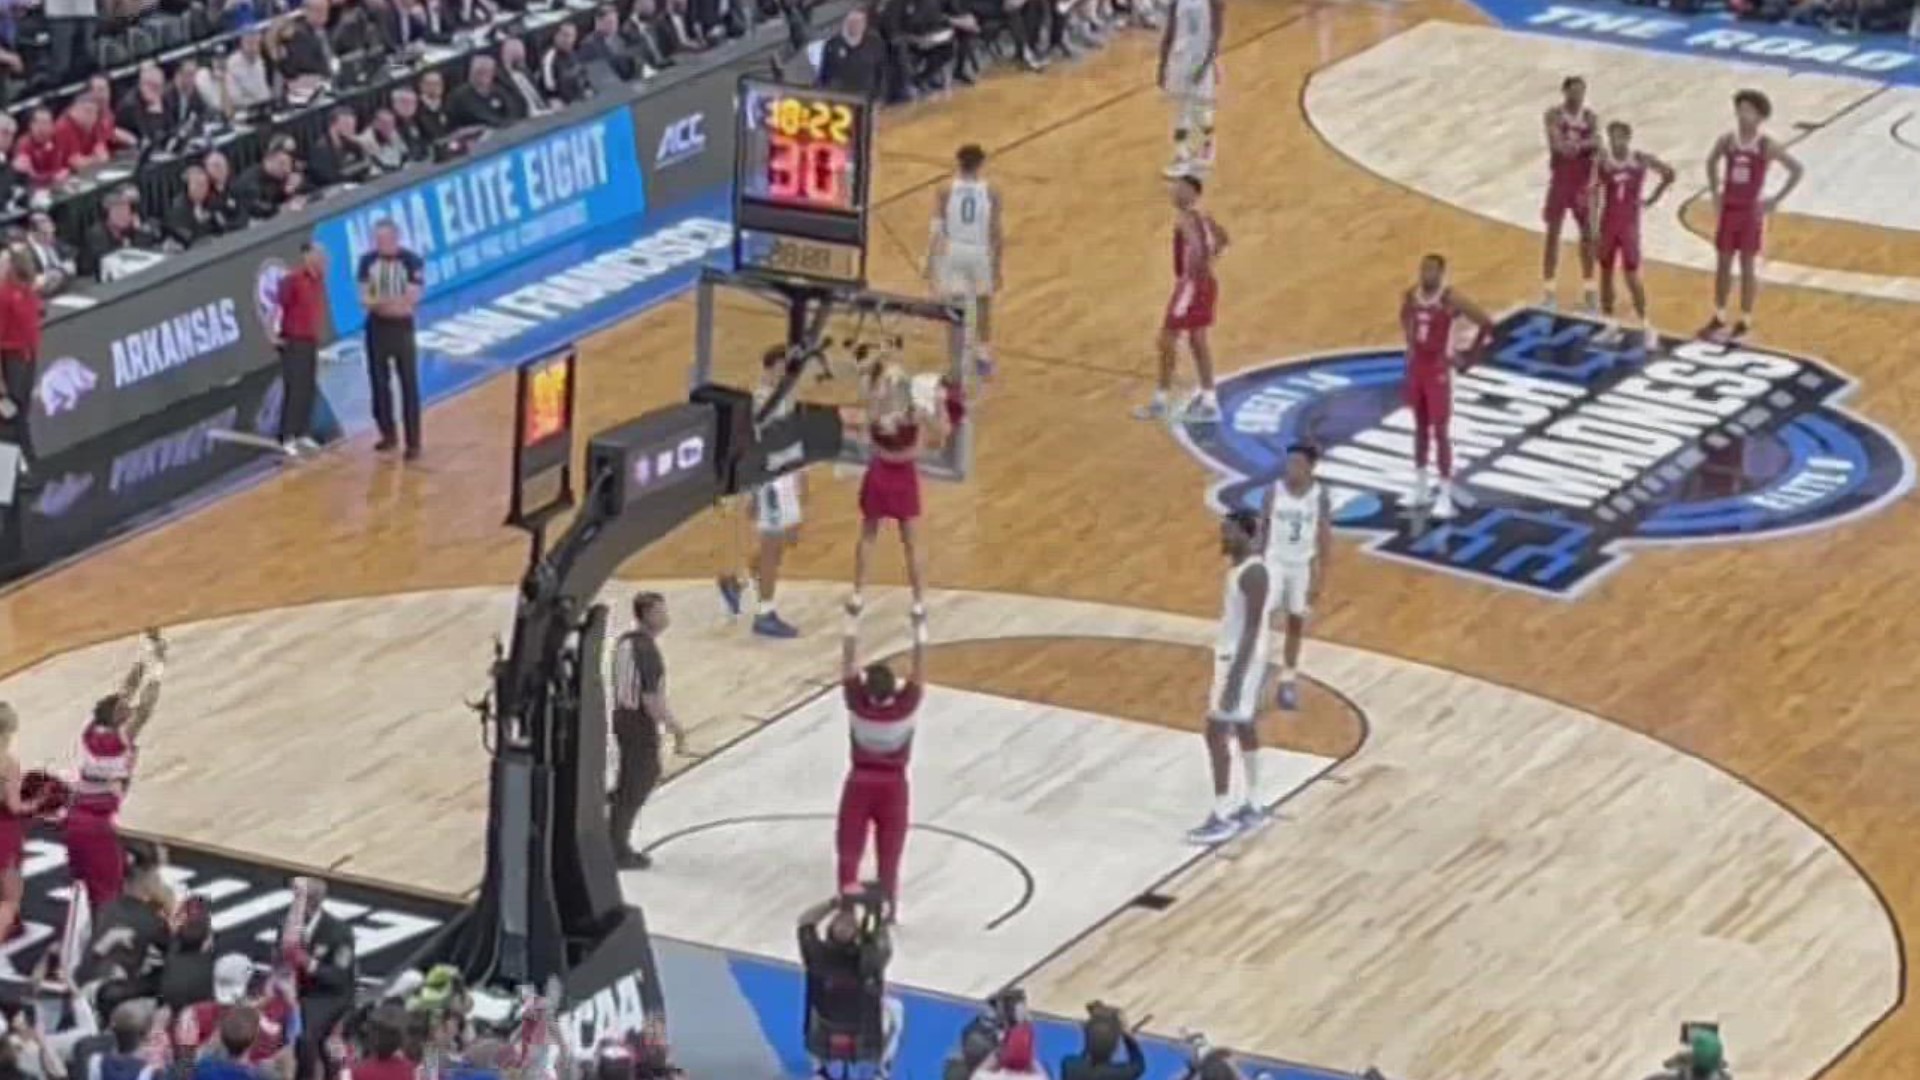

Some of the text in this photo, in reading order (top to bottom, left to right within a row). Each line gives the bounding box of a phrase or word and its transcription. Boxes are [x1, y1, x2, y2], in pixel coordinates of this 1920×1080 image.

[1526, 5, 1915, 71] THE ROAD
[656, 112, 706, 161] ACC
[436, 152, 521, 245] ELITE
[523, 122, 608, 208] EIGHT
[960, 195, 977, 225] 0
[110, 298, 240, 389] ARKANSAS
[416, 307, 541, 356] SAN
[1467, 339, 1802, 509] MADNESS
[1289, 520, 1302, 543] 3
